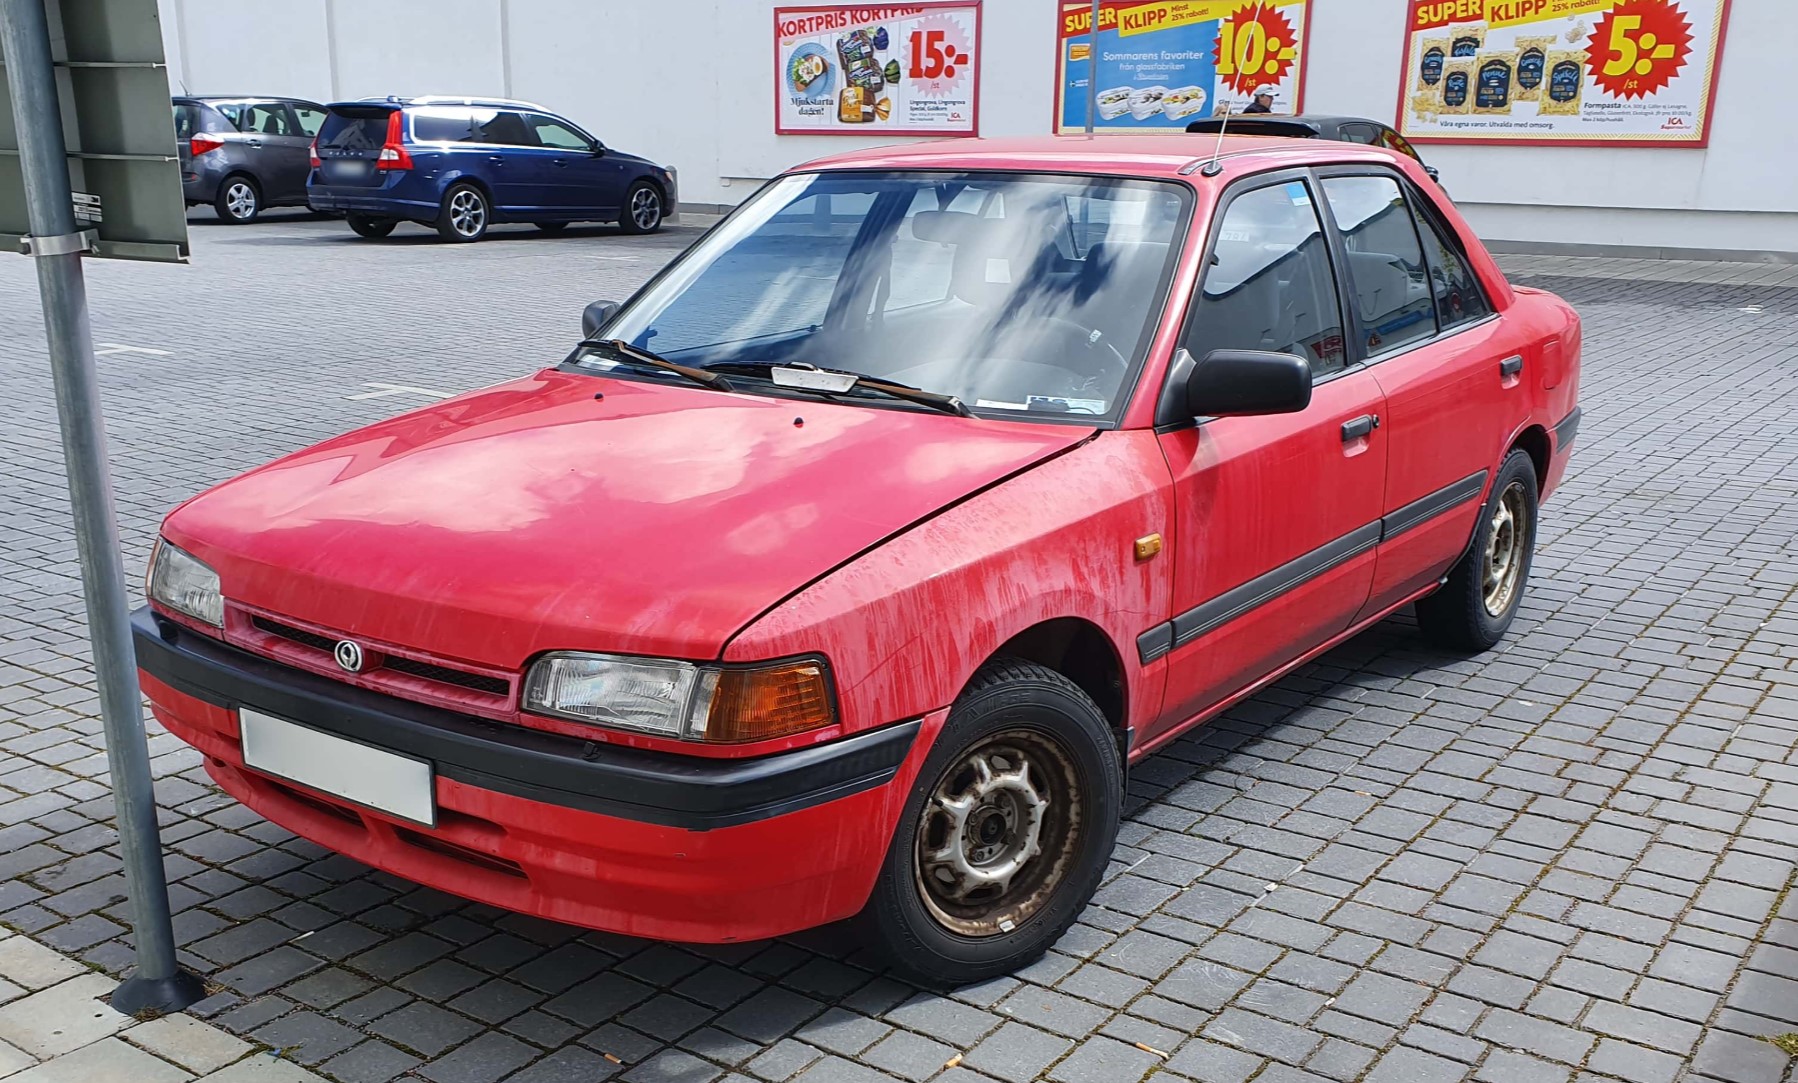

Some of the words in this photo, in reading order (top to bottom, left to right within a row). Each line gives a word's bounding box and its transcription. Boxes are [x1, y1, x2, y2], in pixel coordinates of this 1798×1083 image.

[1171, 3, 1189, 13] Minst
[1417, 0, 1482, 24] SUPER
[1490, 0, 1547, 22] KLIPP
[1552, 2, 1569, 12] 25%
[1123, 8, 1167, 30] KLIPP
[1171, 13, 1185, 21] 25%
[1185, 8, 1209, 18] rabatt!
[777, 11, 847, 38] KORTPRIS
[1216, 20, 1296, 75] 10:-
[1602, 15, 1676, 76] 5:-
[909, 30, 969, 79] 15:-
[1103, 51, 1158, 61] Sommarens
[1160, 50, 1204, 60] favoriter
[1119, 63, 1134, 71] från
[1136, 62, 1185, 72] glassfabriken
[1244, 78, 1257, 88] /st
[1623, 79, 1639, 90] /st
[1583, 102, 1622, 110] Formpasta
[1529, 122, 1554, 130] omsorg.
[1667, 117, 1683, 125] ICA
